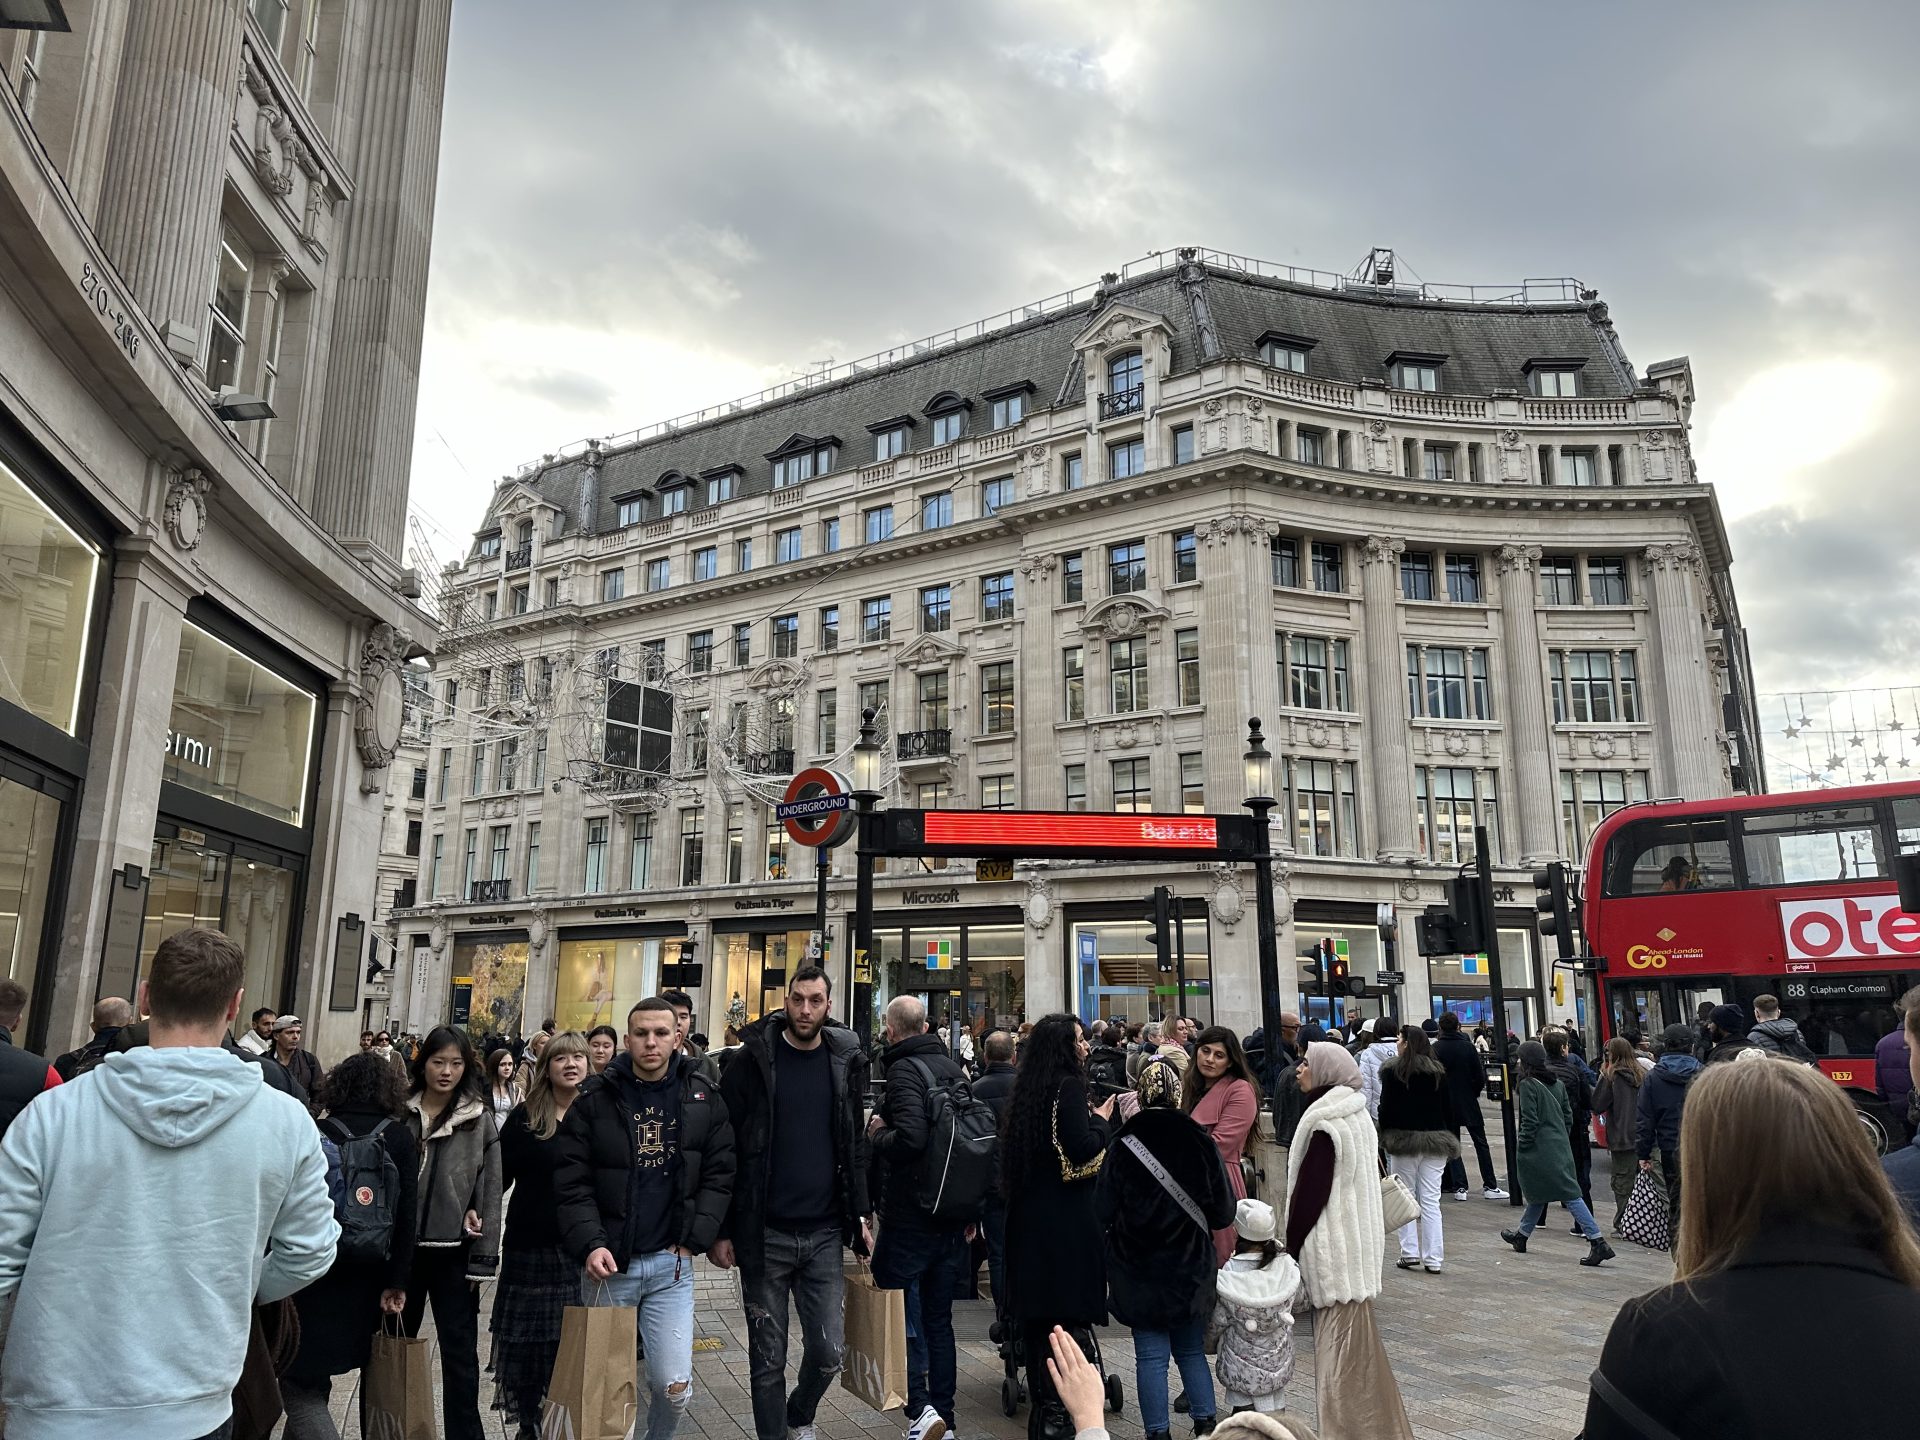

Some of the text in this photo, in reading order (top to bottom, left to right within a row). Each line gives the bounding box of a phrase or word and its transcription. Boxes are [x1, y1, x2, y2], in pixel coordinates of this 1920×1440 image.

[779, 797, 846, 817] UNDERGROUND
[980, 865, 1011, 878] RVP
[902, 888, 960, 905] Microsoft
[735, 898, 794, 910] Onitsuka Tiger
[594, 907, 647, 918] Onitsuka Tiger
[469, 915, 515, 925] Onitsuka Tiger
[1626, 944, 1667, 969] Go
[1791, 964, 1810, 972] global
[1787, 983, 1886, 997] 88 Clapham Common
[1833, 1072, 1851, 1080] 137
